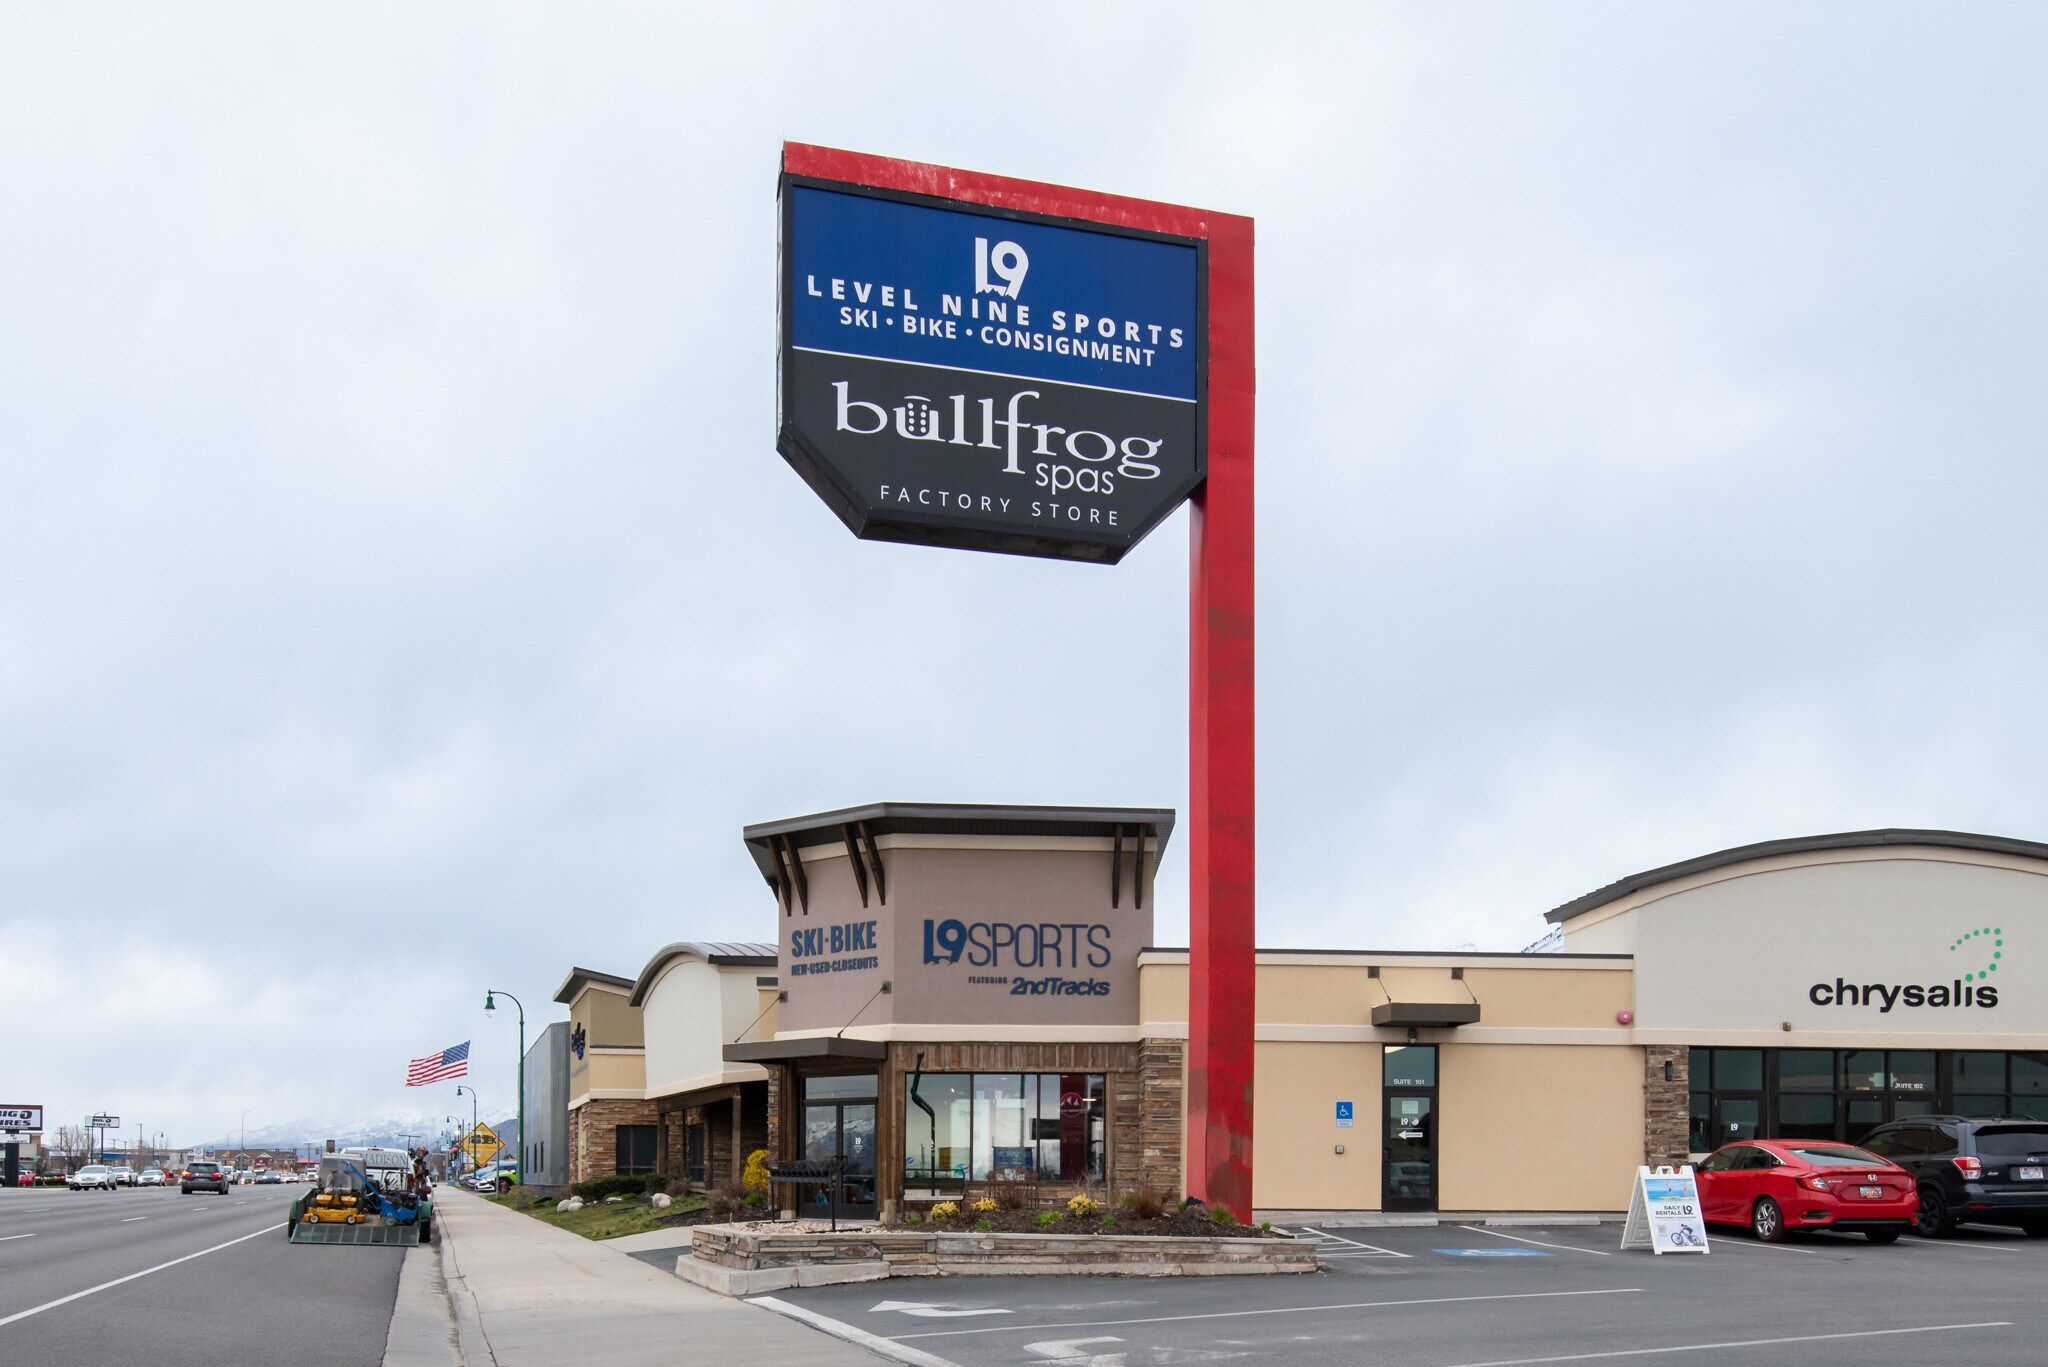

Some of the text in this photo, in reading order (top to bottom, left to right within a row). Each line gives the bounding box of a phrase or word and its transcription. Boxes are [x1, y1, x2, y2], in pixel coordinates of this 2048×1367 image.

[974, 236, 1030, 300] L9
[807, 274, 1184, 349] LEVEL NINE SPORTS
[839, 306, 1155, 367] SKI BIKE CONSIGNMENT
[830, 379, 1164, 481] bullfrog
[1035, 459, 1115, 496] spas
[880, 484, 1119, 526] FACTORY STORE
[968, 976, 1008, 984] FEATURING
[1808, 977, 1999, 1013] chrysalis
[0, 1119, 32, 1127] IRES
